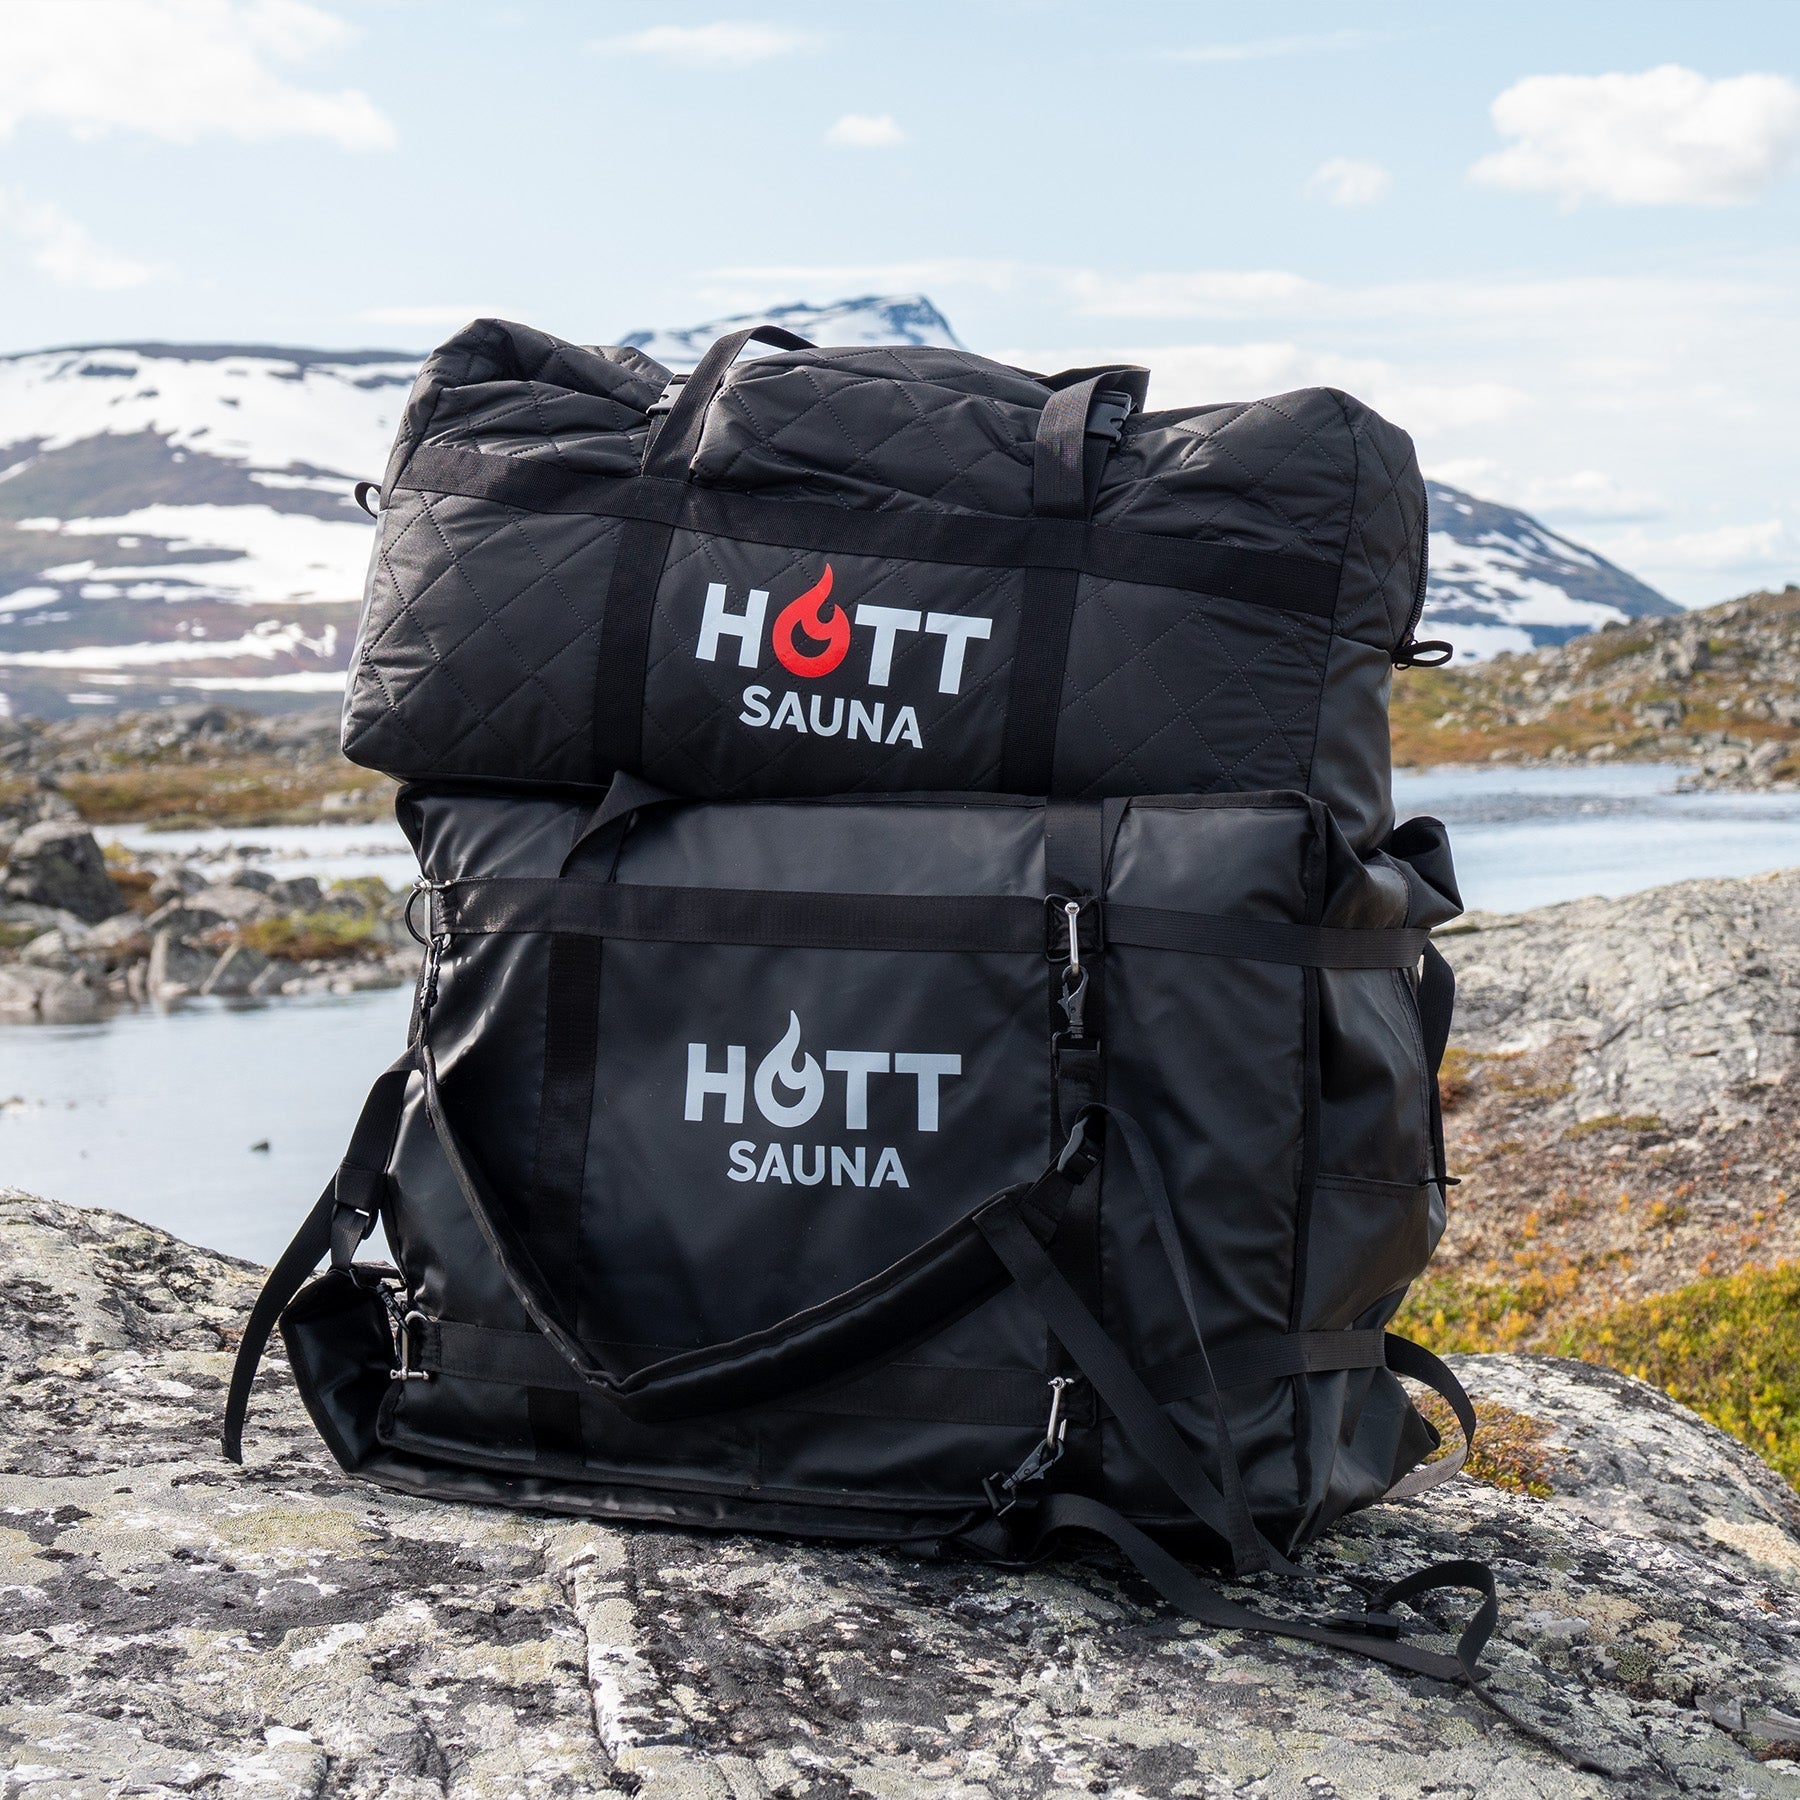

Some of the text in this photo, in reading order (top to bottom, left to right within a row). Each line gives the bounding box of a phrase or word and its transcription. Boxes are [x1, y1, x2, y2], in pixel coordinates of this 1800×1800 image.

[695, 563, 993, 695] HOTT
[738, 685, 923, 749] SAUNA
[684, 1010, 962, 1132] HOTT
[726, 1140, 910, 1188] SAUNA
